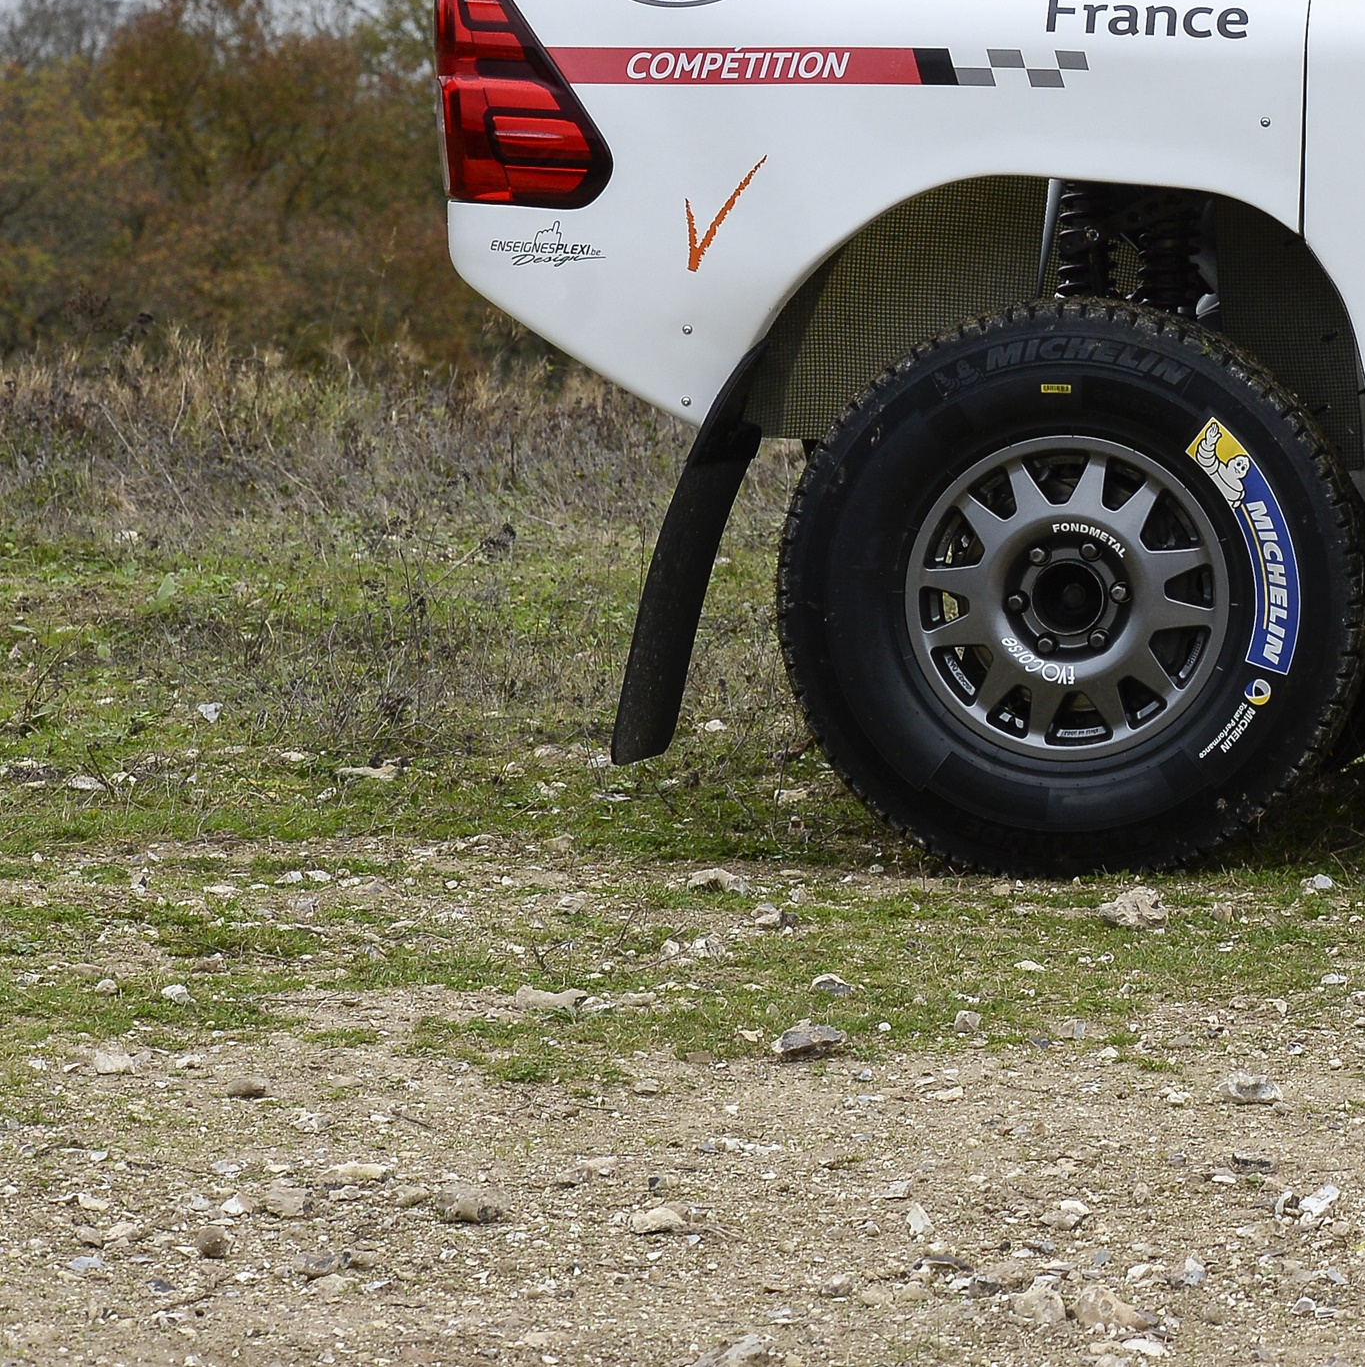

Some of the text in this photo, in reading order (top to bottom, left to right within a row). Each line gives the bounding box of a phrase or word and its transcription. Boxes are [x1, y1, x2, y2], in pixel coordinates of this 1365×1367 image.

[626, 47, 851, 82] COMPÉTITION
[511, 253, 606, 267] Design
[986, 337, 1192, 386] MICHELIN
[1051, 522, 1127, 559] FONDMETAL
[1245, 500, 1289, 666] MICHELIN
[1198, 701, 1248, 759] Total Performance
[1219, 706, 1257, 754] MICHELIN
